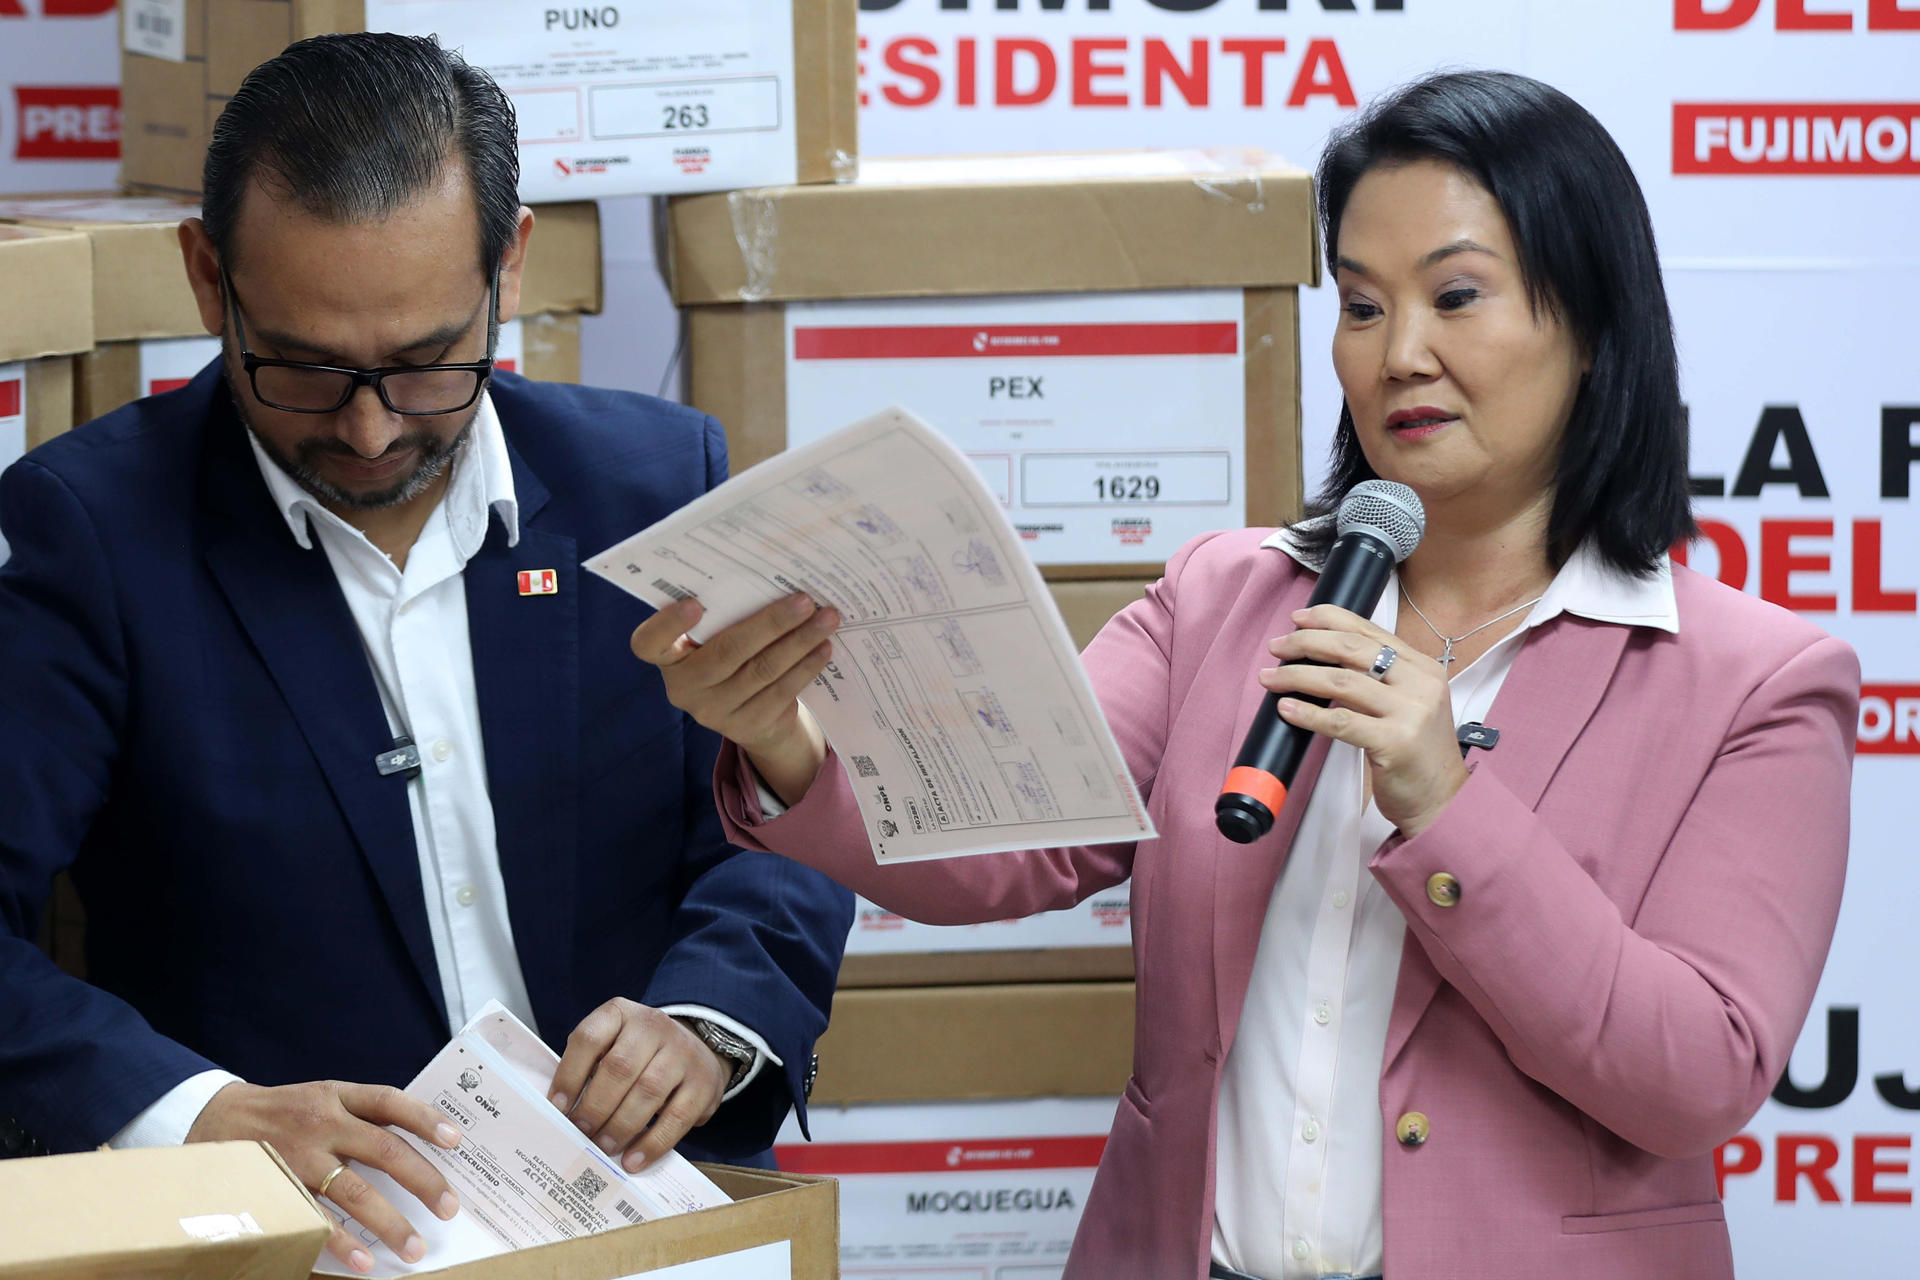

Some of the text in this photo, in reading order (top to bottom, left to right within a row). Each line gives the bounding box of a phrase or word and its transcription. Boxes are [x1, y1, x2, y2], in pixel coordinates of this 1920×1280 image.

[545, 7, 619, 31] PUNO
[858, 36, 1359, 108] SIDENTA
[23, 104, 121, 142] PRE
[663, 105, 709, 129] 263
[989, 376, 1045, 400] PEX
[1093, 476, 1160, 500] 1629
[877, 784, 892, 812] ONPE
[439, 1098, 470, 1126] 030716
[473, 1093, 501, 1119] ONPE
[458, 1149, 500, 1187] ESCRUTINIO
[475, 1151, 501, 1175] SANCHEZ
[513, 1148, 541, 1173] SEGUNDA
[521, 1165, 548, 1190] ACTA
[546, 1187, 598, 1234] ELECTORAL
[532, 1154, 610, 1224] ELECCIONES GENERALES 2026
[907, 1189, 1075, 1215] MOQUEGUA
